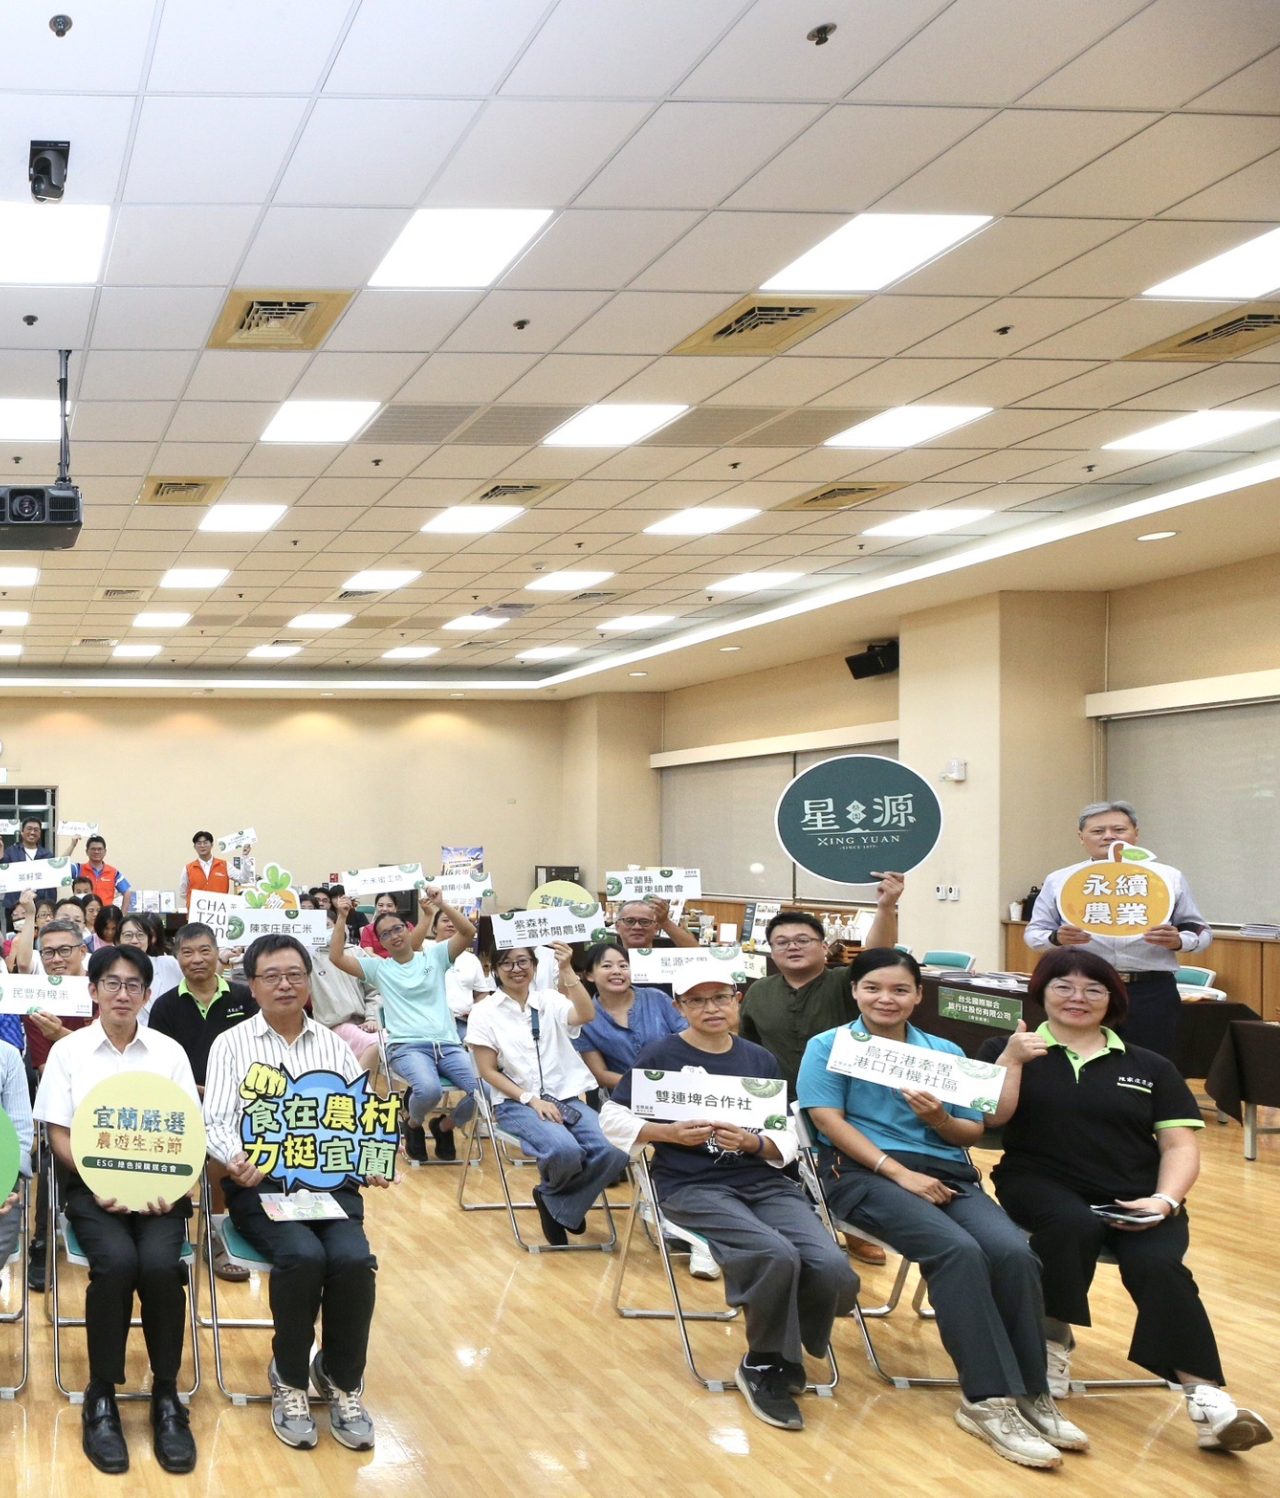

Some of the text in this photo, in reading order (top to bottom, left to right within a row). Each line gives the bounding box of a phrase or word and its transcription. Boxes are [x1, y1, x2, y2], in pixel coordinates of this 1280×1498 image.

[817, 835, 900, 846] XING YUAN
[624, 876, 654, 885] 宜蘭縣
[634, 884, 684, 894] 羅東鎮農會
[1083, 874, 1149, 897] 永續
[196, 899, 227, 913] CHA
[1082, 902, 1149, 926] 農業
[249, 923, 312, 934] 陳家庄居仁米
[514, 917, 548, 930] 紫森林
[517, 924, 586, 941] 三富休閒農場
[13, 988, 69, 1000] 民豐有機米
[958, 995, 1000, 1009] 台北國際聯合
[948, 1001, 1011, 1021] 旅行社股份有限公司
[853, 1054, 959, 1093] 港口有機社區
[655, 1089, 753, 1112] 雙連埤合作社
[93, 1105, 185, 1135] 宜蘭嚴選
[243, 1092, 401, 1135] 食在農村
[96, 1131, 182, 1155] 農遊生活節
[243, 1132, 398, 1180] 力挺宜蘭
[96, 1159, 177, 1173] ESG 綠色採購媒合會
